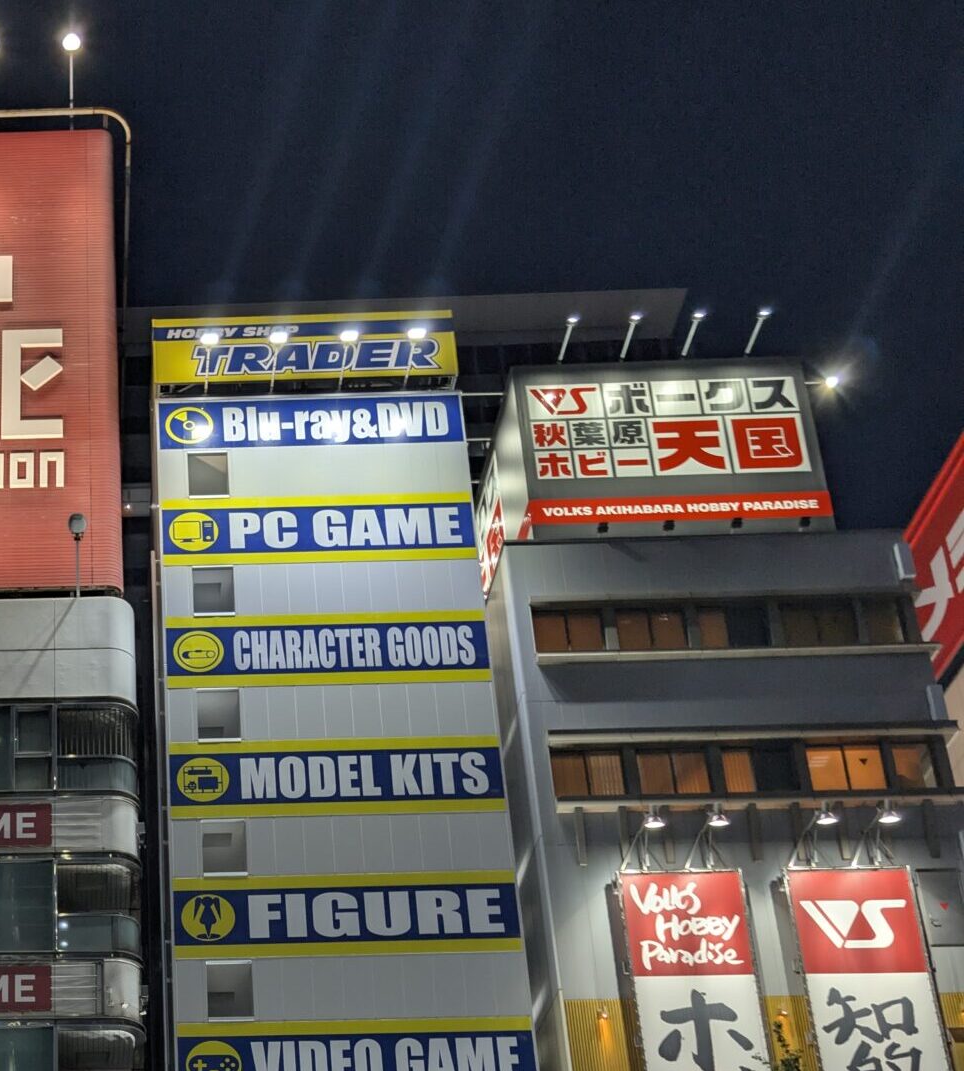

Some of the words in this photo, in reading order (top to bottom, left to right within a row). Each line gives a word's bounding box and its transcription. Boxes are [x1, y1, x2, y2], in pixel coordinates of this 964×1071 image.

[192, 339, 442, 376] TRADER
[606, 378, 797, 415] ボークス
[223, 401, 449, 443] Blu-ray&DVD
[533, 420, 645, 448] 秋葉原
[538, 453, 648, 477] ホビー
[652, 417, 804, 471] 天国
[229, 510, 298, 549] PC
[312, 507, 463, 547] GAME
[542, 505, 594, 518] VOLKS
[595, 503, 684, 516] AKIHABARA
[687, 501, 741, 514] HOBBY
[743, 499, 819, 512] PARADISE
[233, 628, 382, 671] CHARACTER
[387, 625, 477, 667] GOODS
[240, 755, 382, 799] MODEL
[390, 752, 489, 795] KITS
[248, 889, 505, 939] FIGURE
